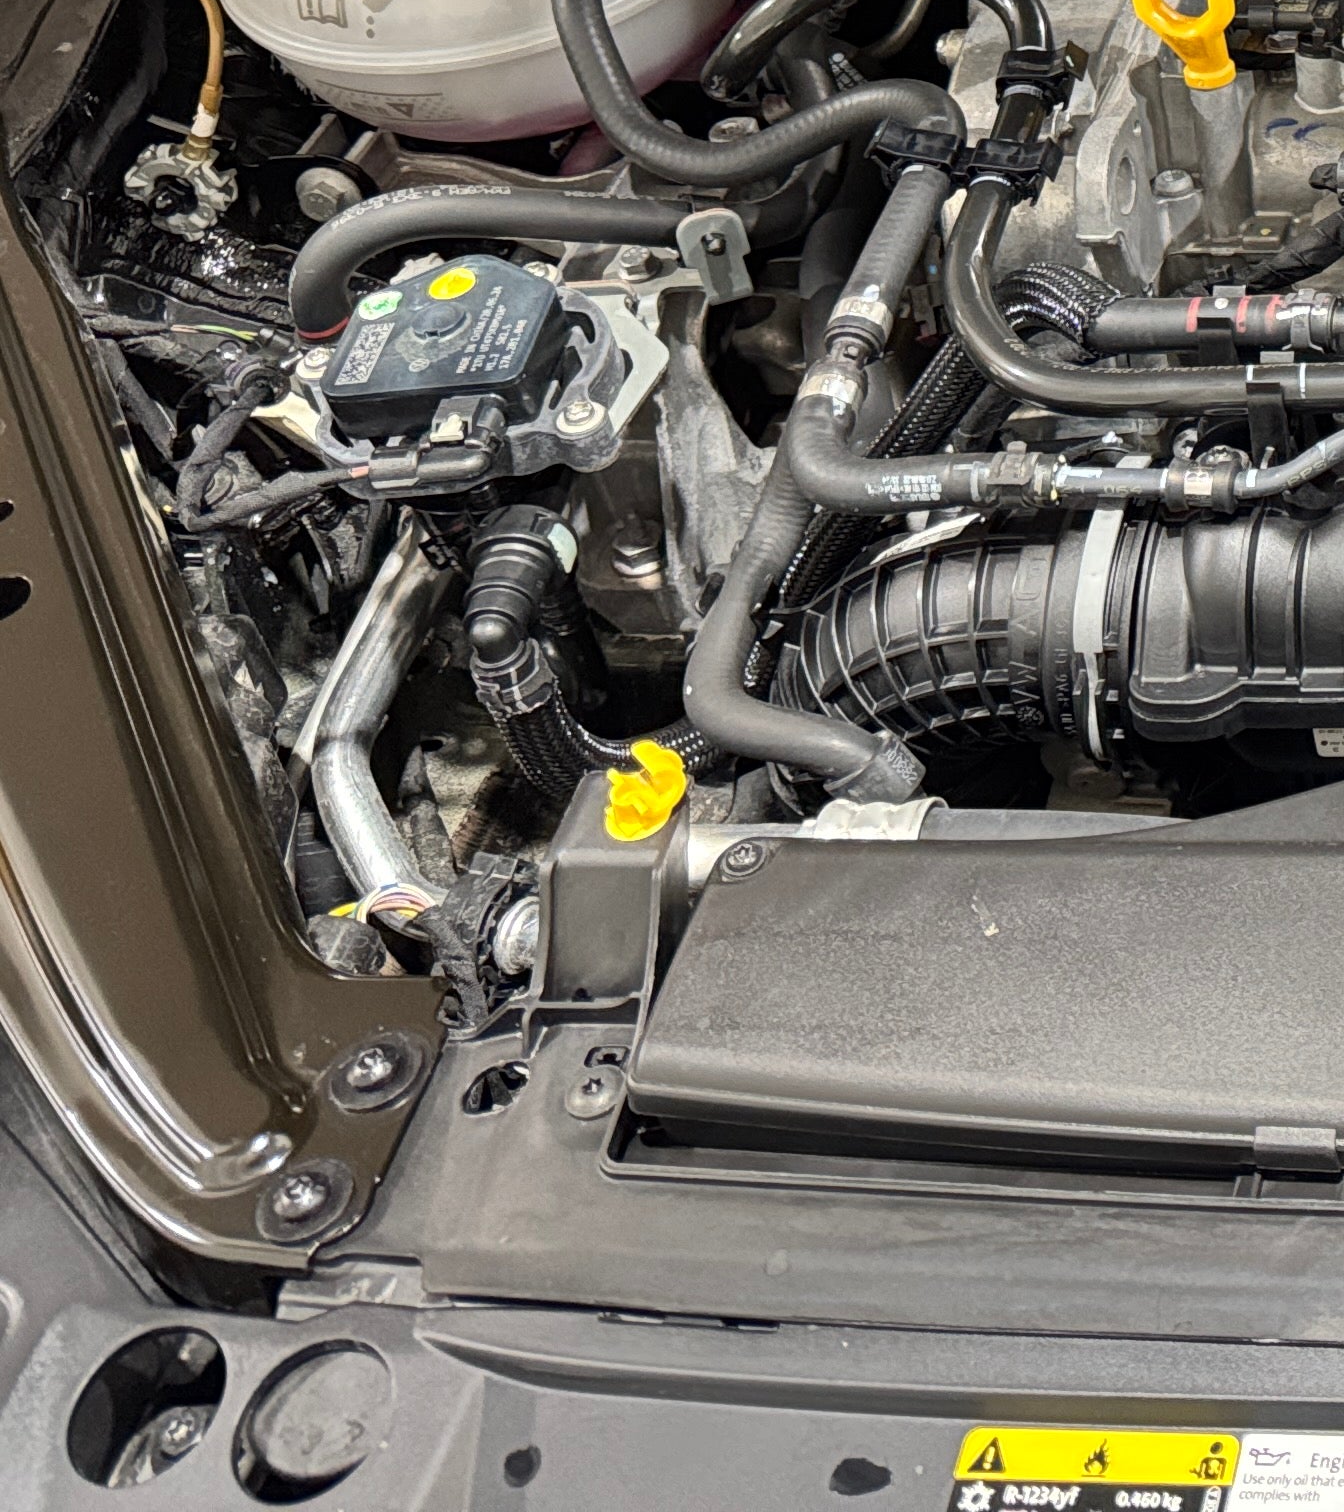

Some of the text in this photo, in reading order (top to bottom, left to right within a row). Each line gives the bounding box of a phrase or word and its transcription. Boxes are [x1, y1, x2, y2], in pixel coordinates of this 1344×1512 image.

[1243, 1473, 1265, 1485] Use
[1266, 1474, 1292, 1489] only
[1293, 1475, 1309, 1487] oil
[1310, 1476, 1335, 1488] that
[1002, 1485, 1081, 1508] R-1234yf
[1162, 1492, 1183, 1511] kg
[1239, 1489, 1320, 1503] complies with
